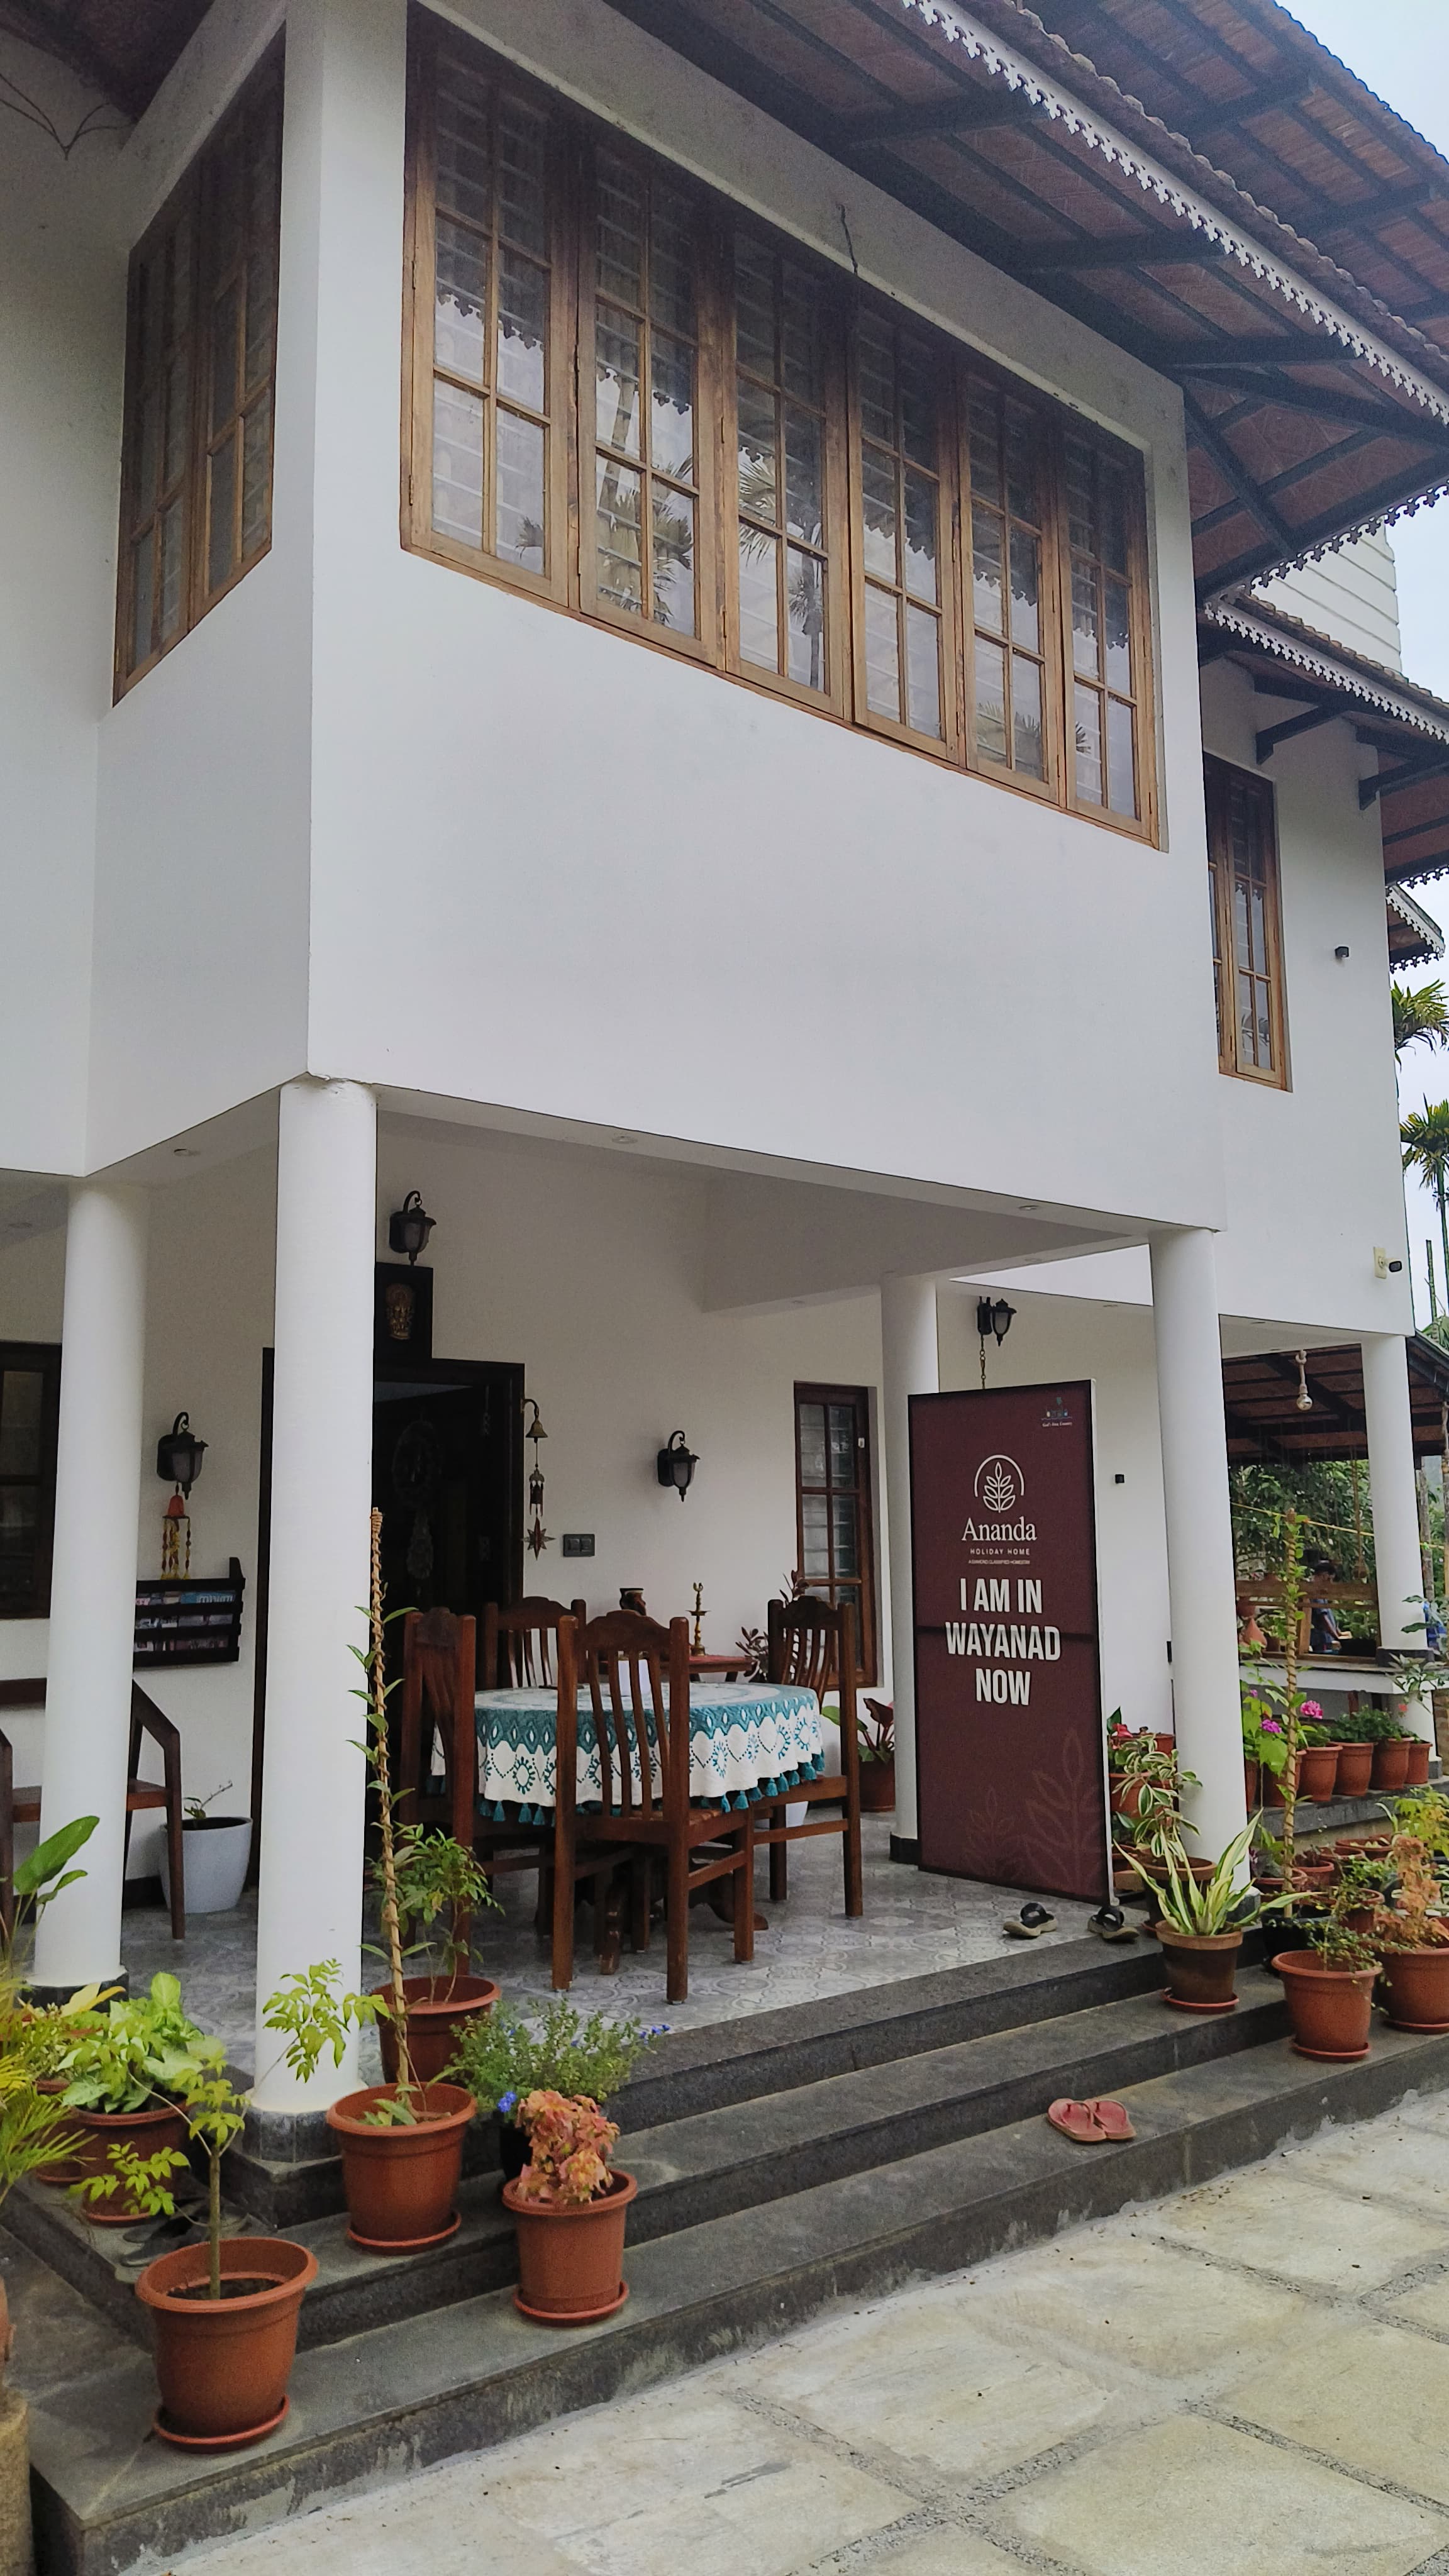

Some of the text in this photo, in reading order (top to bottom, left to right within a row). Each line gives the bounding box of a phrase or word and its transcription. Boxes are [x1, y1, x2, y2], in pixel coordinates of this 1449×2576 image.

[962, 1516, 1037, 1541] Ananda
[960, 1578, 1042, 1614] I AM IN
[945, 1621, 1061, 1661] WAYANAD
[975, 1668, 1031, 1706] NOW
